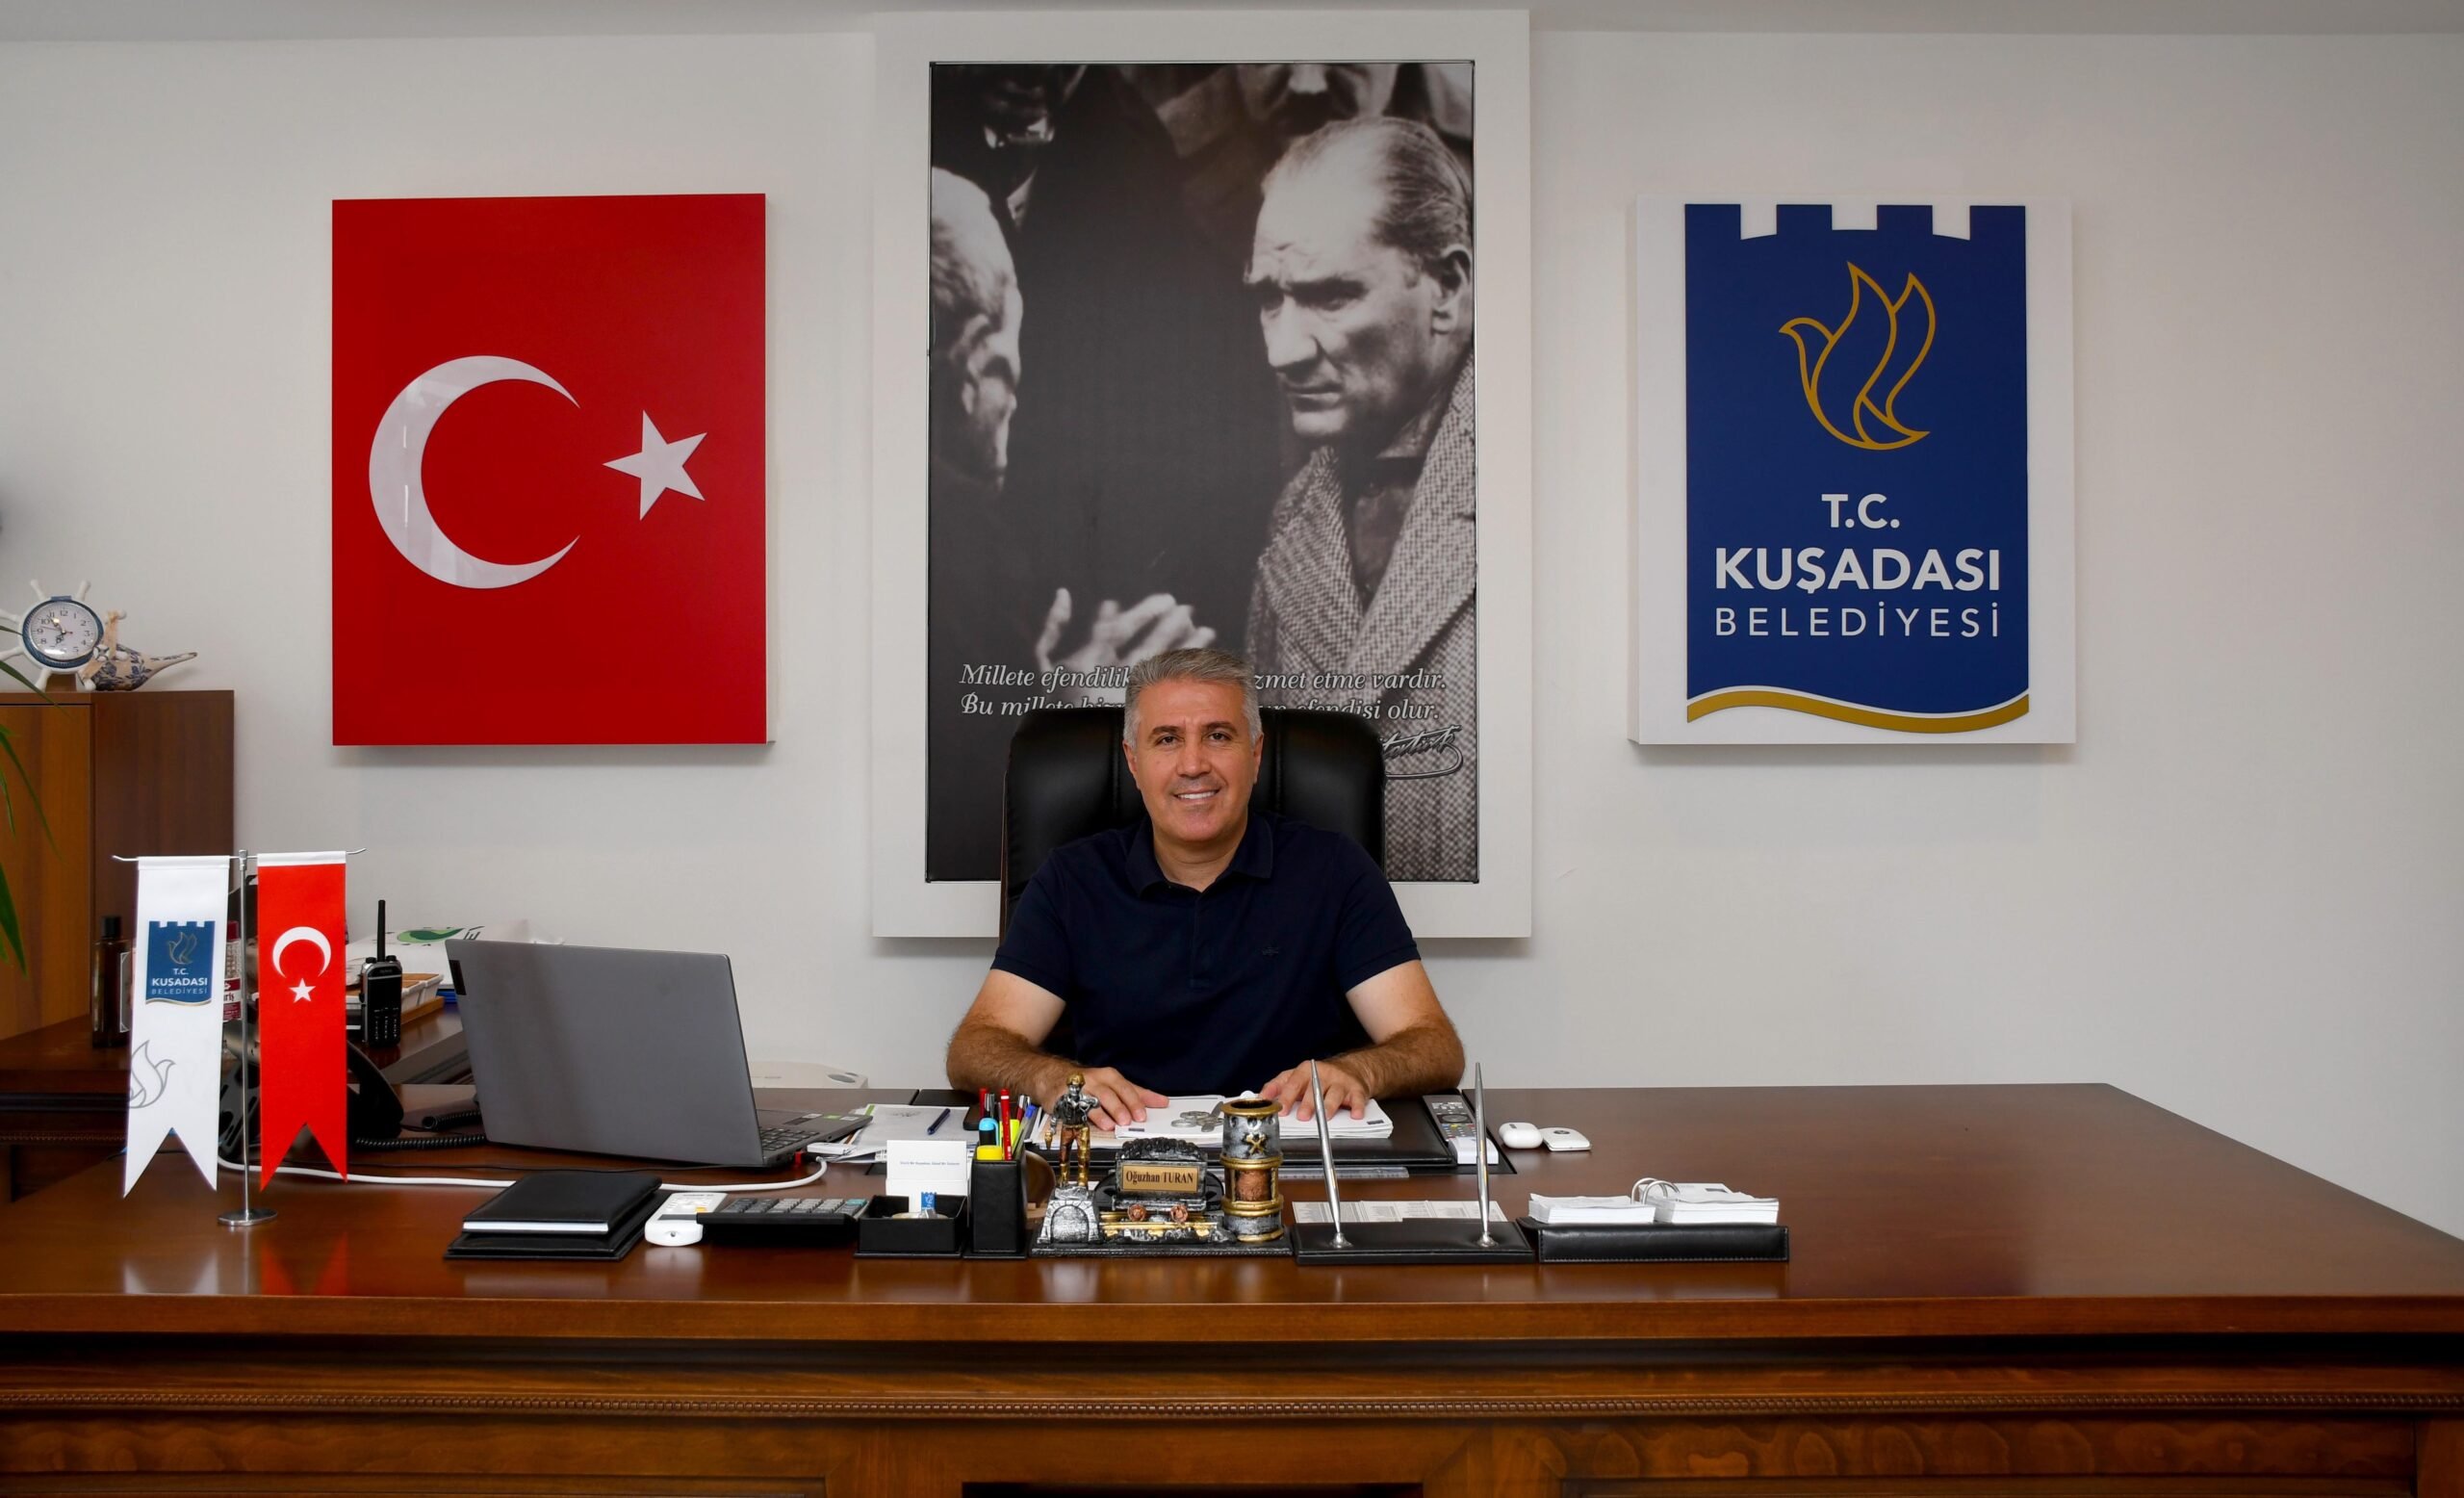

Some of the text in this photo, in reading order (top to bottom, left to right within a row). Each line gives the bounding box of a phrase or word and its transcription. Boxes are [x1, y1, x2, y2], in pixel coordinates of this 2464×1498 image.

[1821, 493, 1900, 529] T.C.
[1715, 547, 2000, 594] KUŞADASI
[1715, 601, 1998, 637] BELEDİYESİ
[959, 663, 1035, 686] Millete
[1253, 671, 1307, 690] zmet
[1313, 672, 1366, 689] etme
[1372, 668, 1447, 690] vardır.
[961, 691, 994, 715] Bu
[1387, 703, 1440, 720] olur.
[1125, 1171, 1194, 1185] Oğuzhan TURAN
